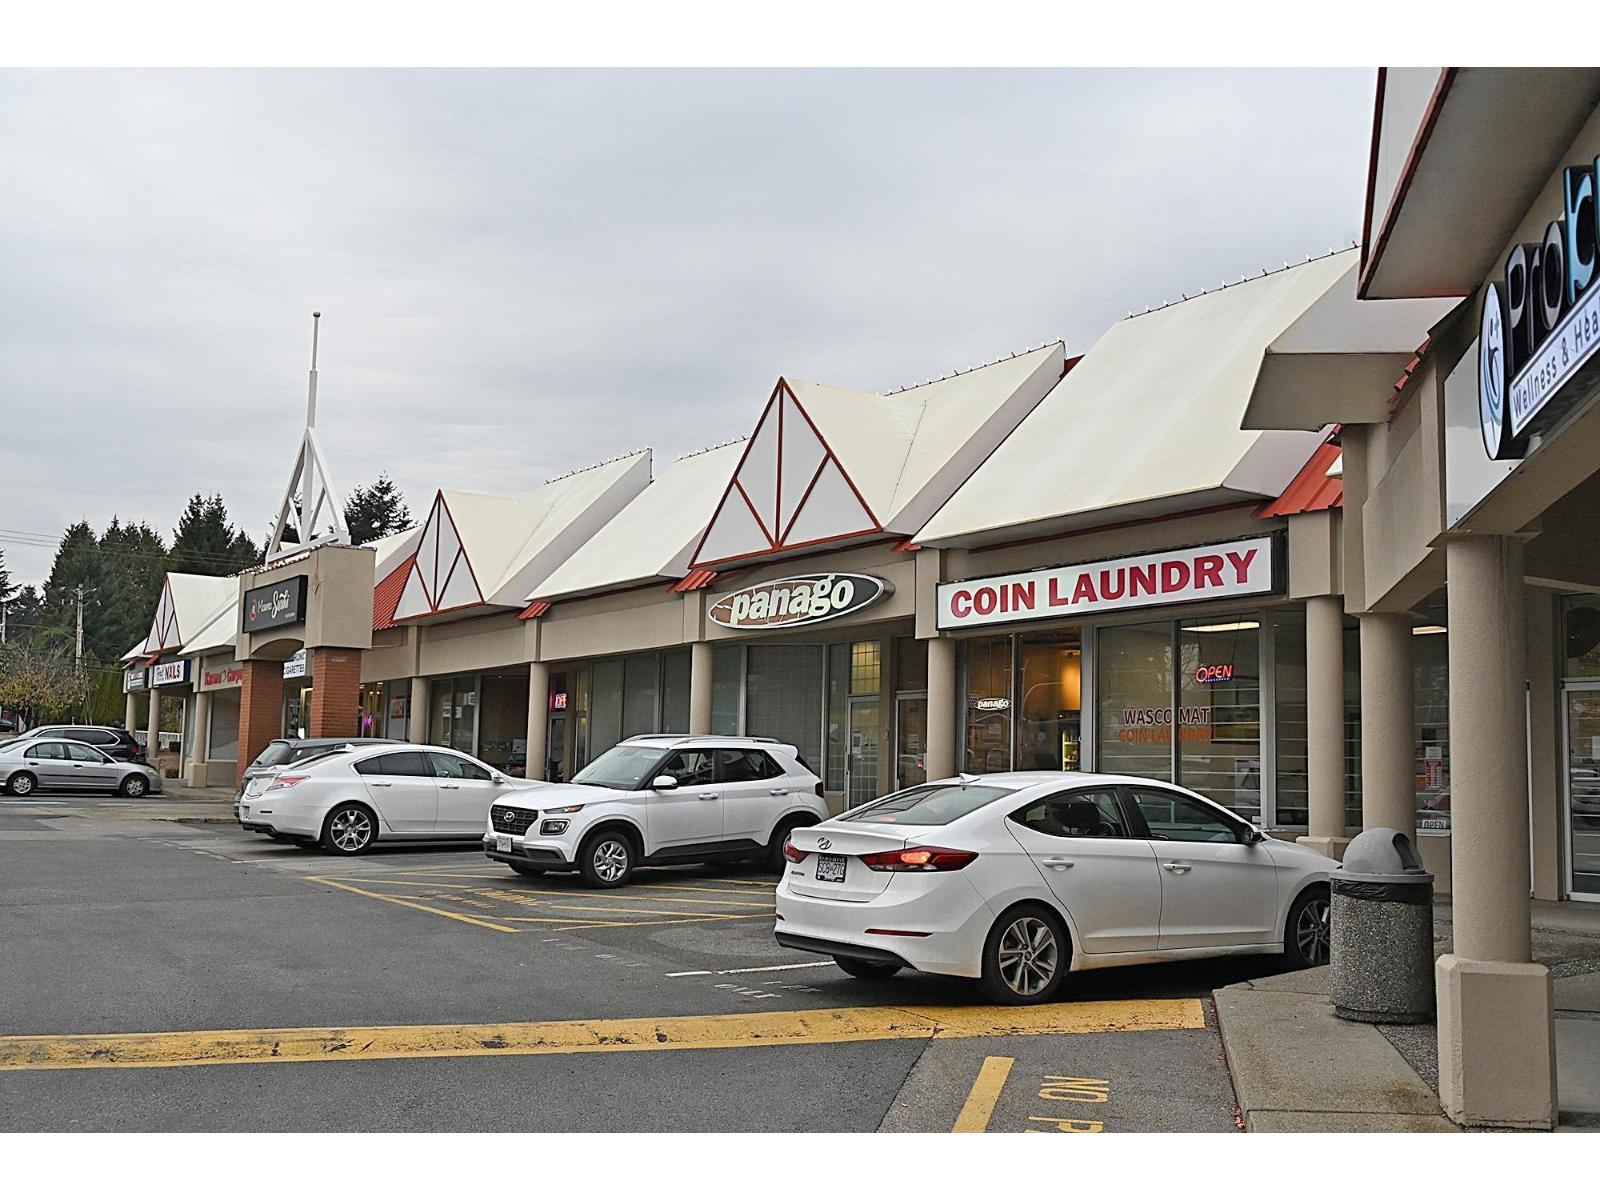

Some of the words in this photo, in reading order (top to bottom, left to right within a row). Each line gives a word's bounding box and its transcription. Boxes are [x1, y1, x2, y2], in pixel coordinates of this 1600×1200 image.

[1513, 358, 1557, 418] Wellness
[1561, 336, 1570, 367] &
[1574, 315, 1600, 351] Hea
[949, 581, 1036, 619] COIN
[1048, 548, 1258, 608] LAUNDRY
[730, 573, 855, 626] panago
[164, 664, 181, 680] NAILS
[1195, 664, 1233, 683] OPEN
[977, 698, 1010, 711] panago
[1118, 728, 1147, 744] COIN
[1423, 820, 1446, 829] OPEN
[1038, 1075, 1109, 1103] NO
